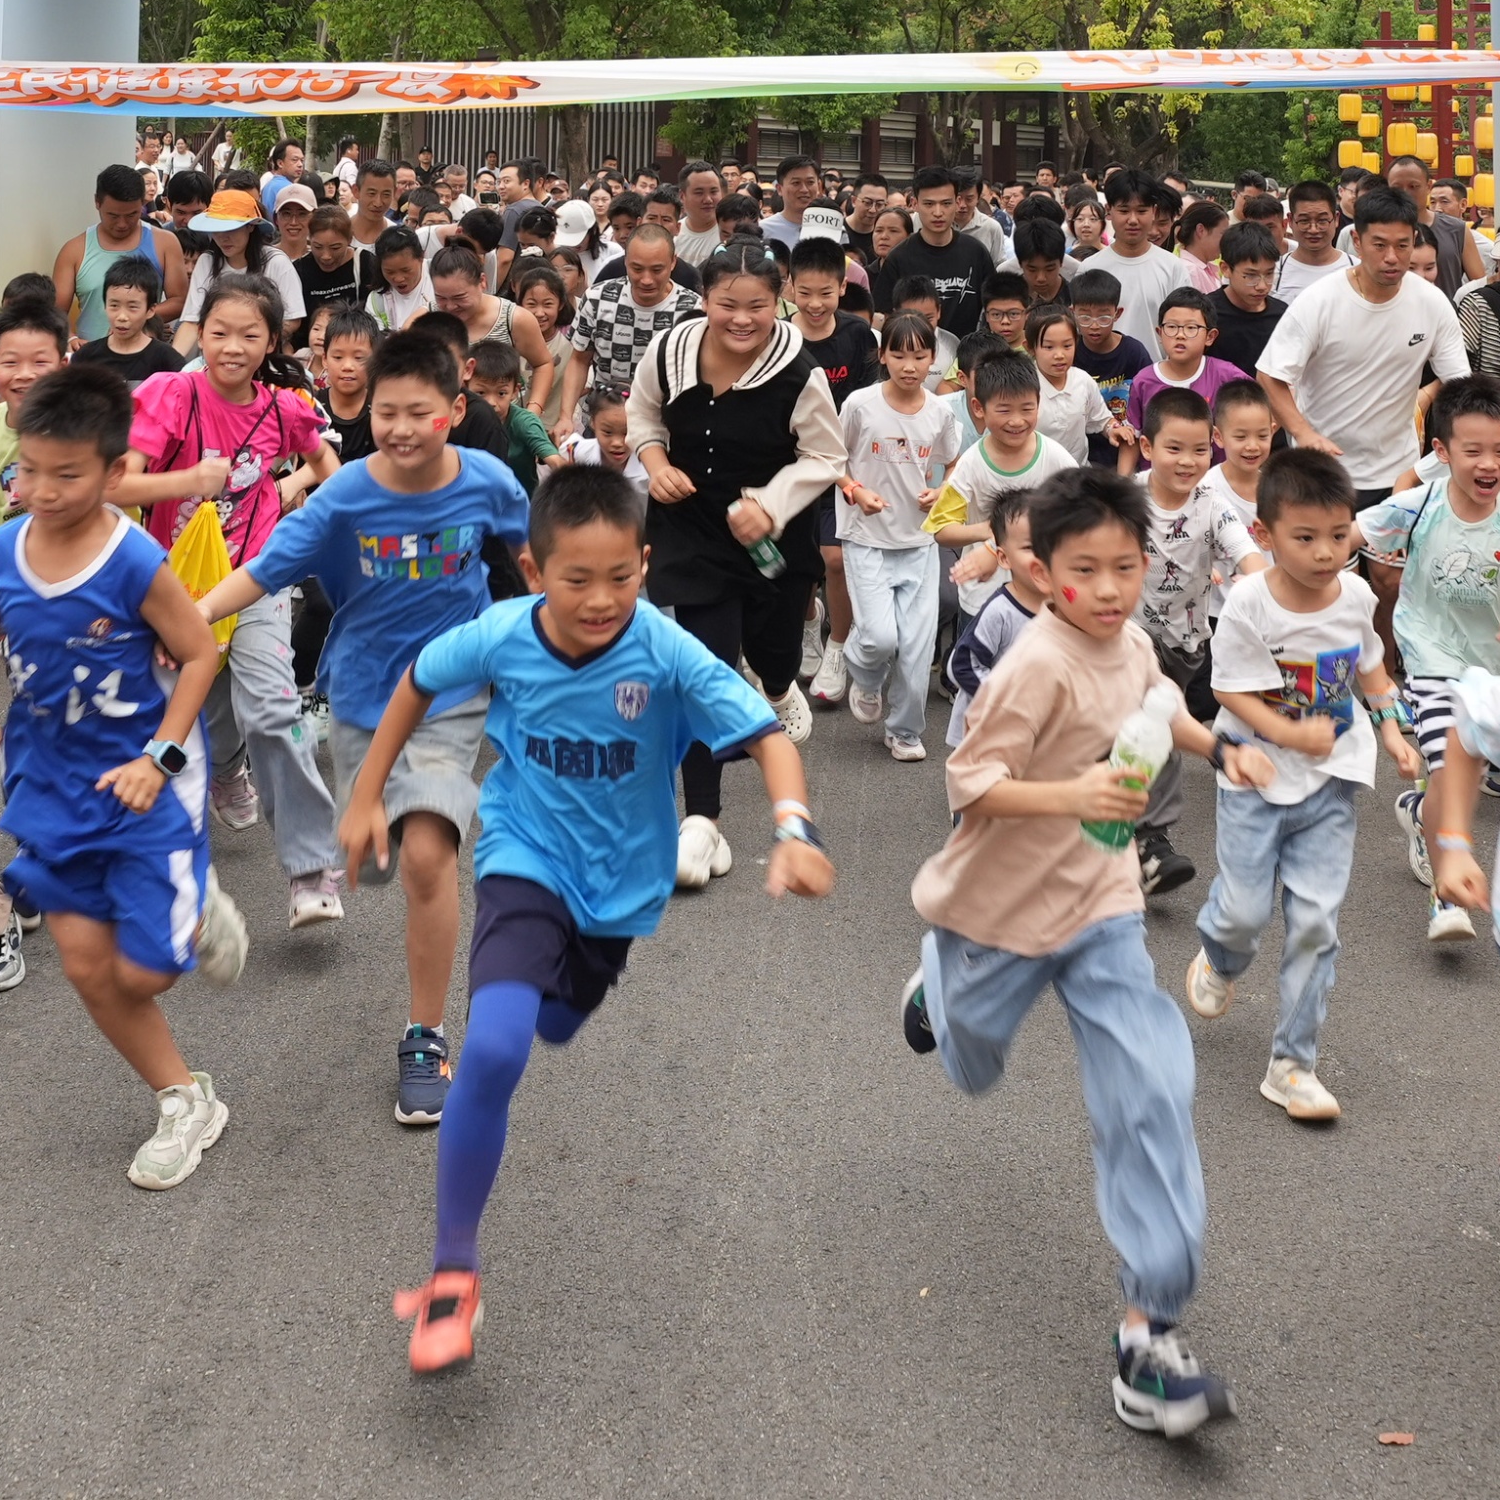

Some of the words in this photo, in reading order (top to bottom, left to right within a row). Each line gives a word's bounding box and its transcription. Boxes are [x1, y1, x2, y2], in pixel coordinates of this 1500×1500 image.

[804, 213, 841, 227] SPORT
[356, 525, 475, 559] MASTER
[359, 551, 473, 580] BUILDER
